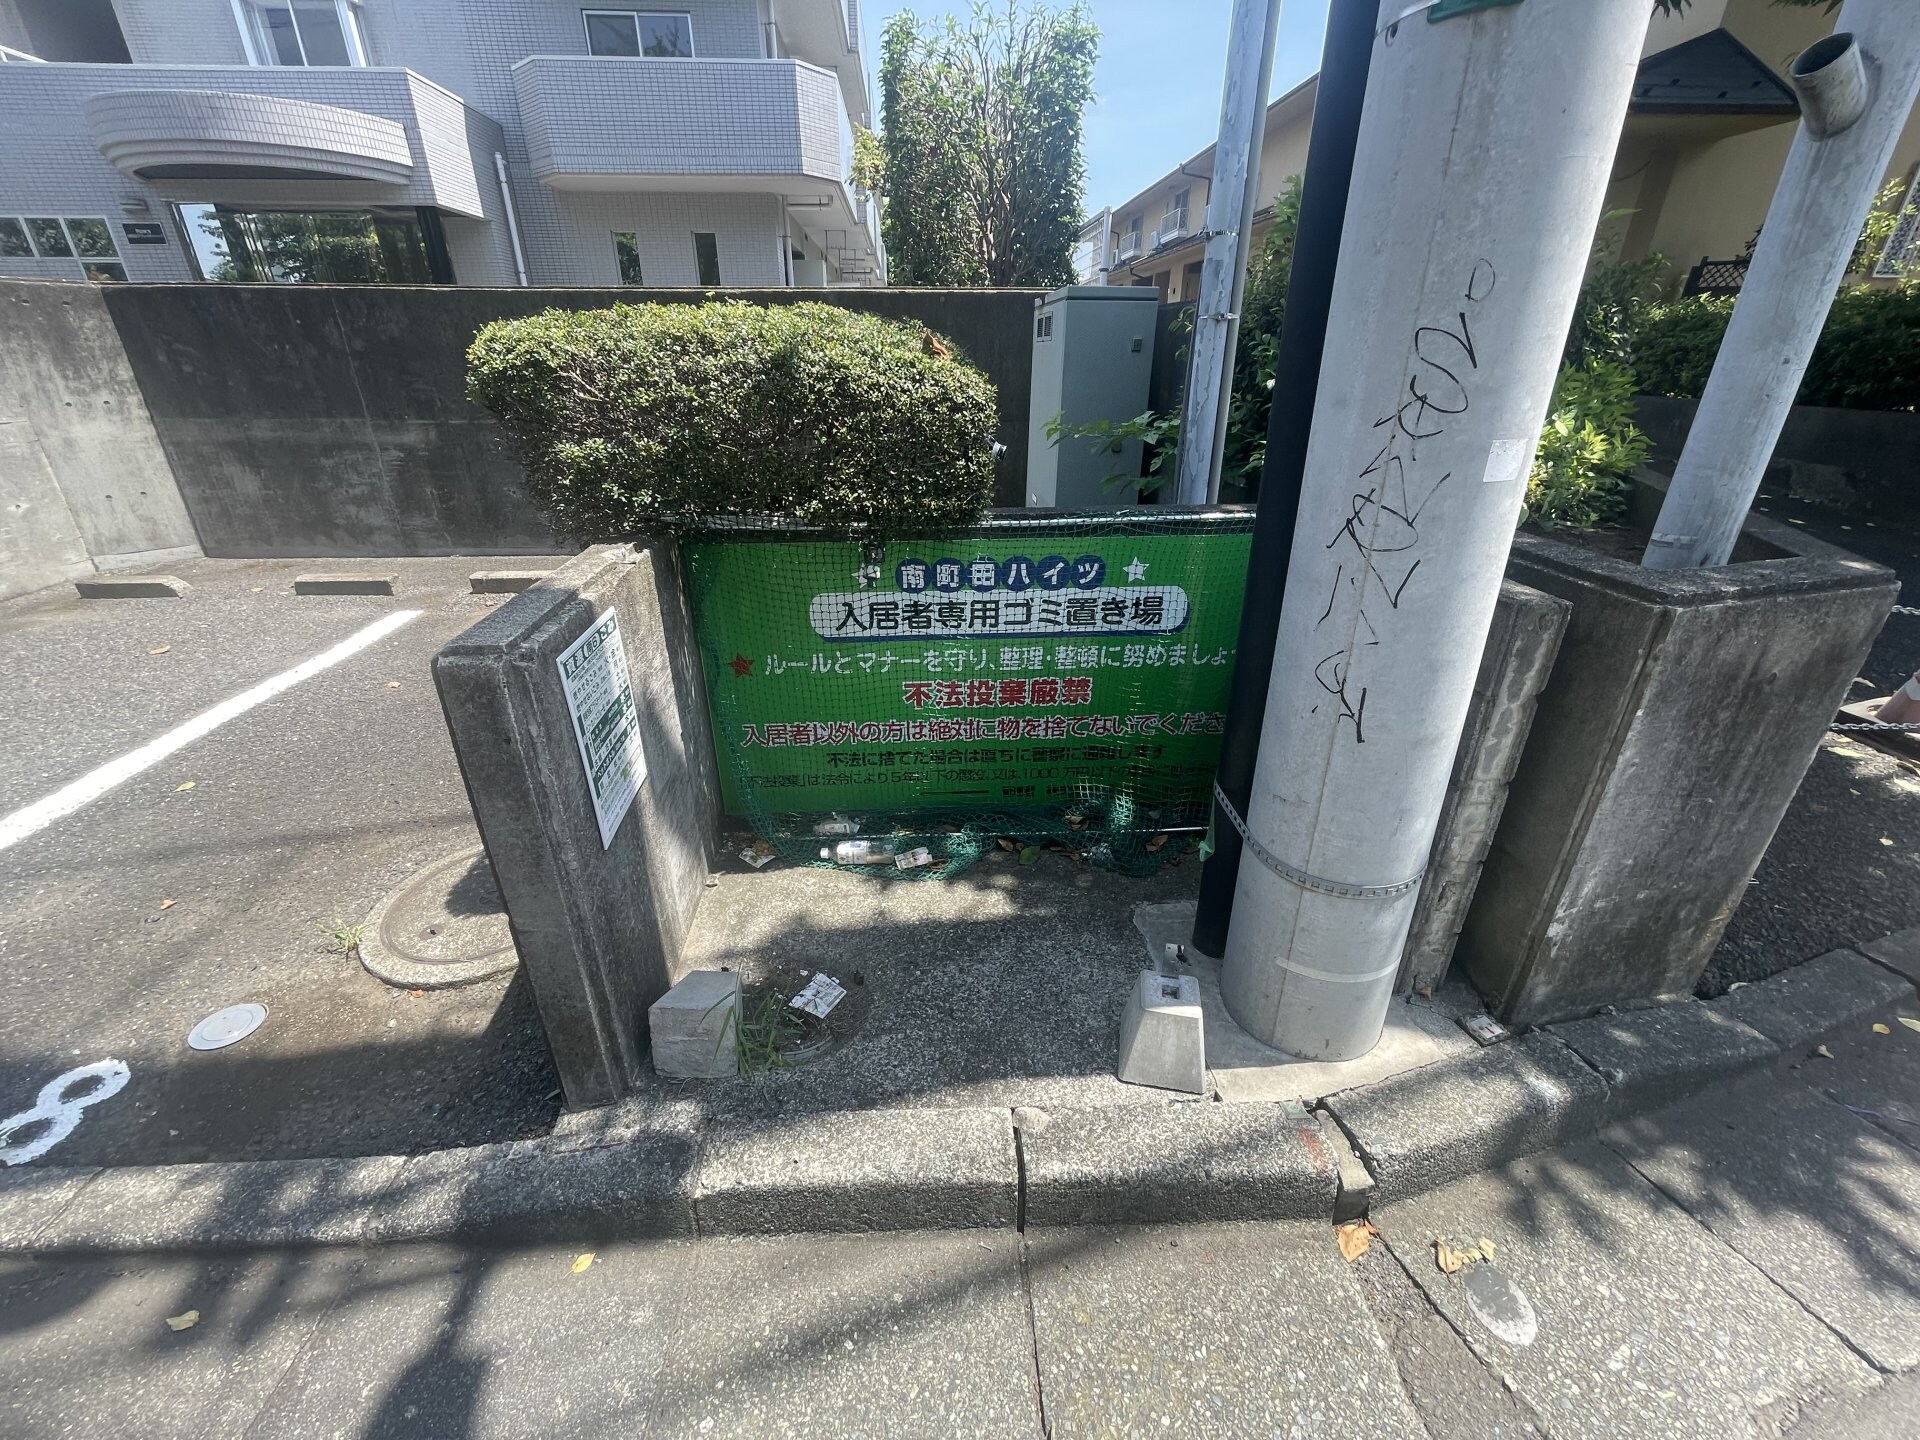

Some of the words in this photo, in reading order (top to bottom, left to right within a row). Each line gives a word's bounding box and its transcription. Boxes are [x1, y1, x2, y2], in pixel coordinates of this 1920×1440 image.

[901, 561, 1100, 590] 南町田ハイツ
[835, 596, 1164, 632] 入居者専用ゴミ置き場
[765, 644, 1236, 676] ルールとマナーを守り、整理・整頓に努めましょ
[902, 677, 1094, 710] 不法投棄厳禁
